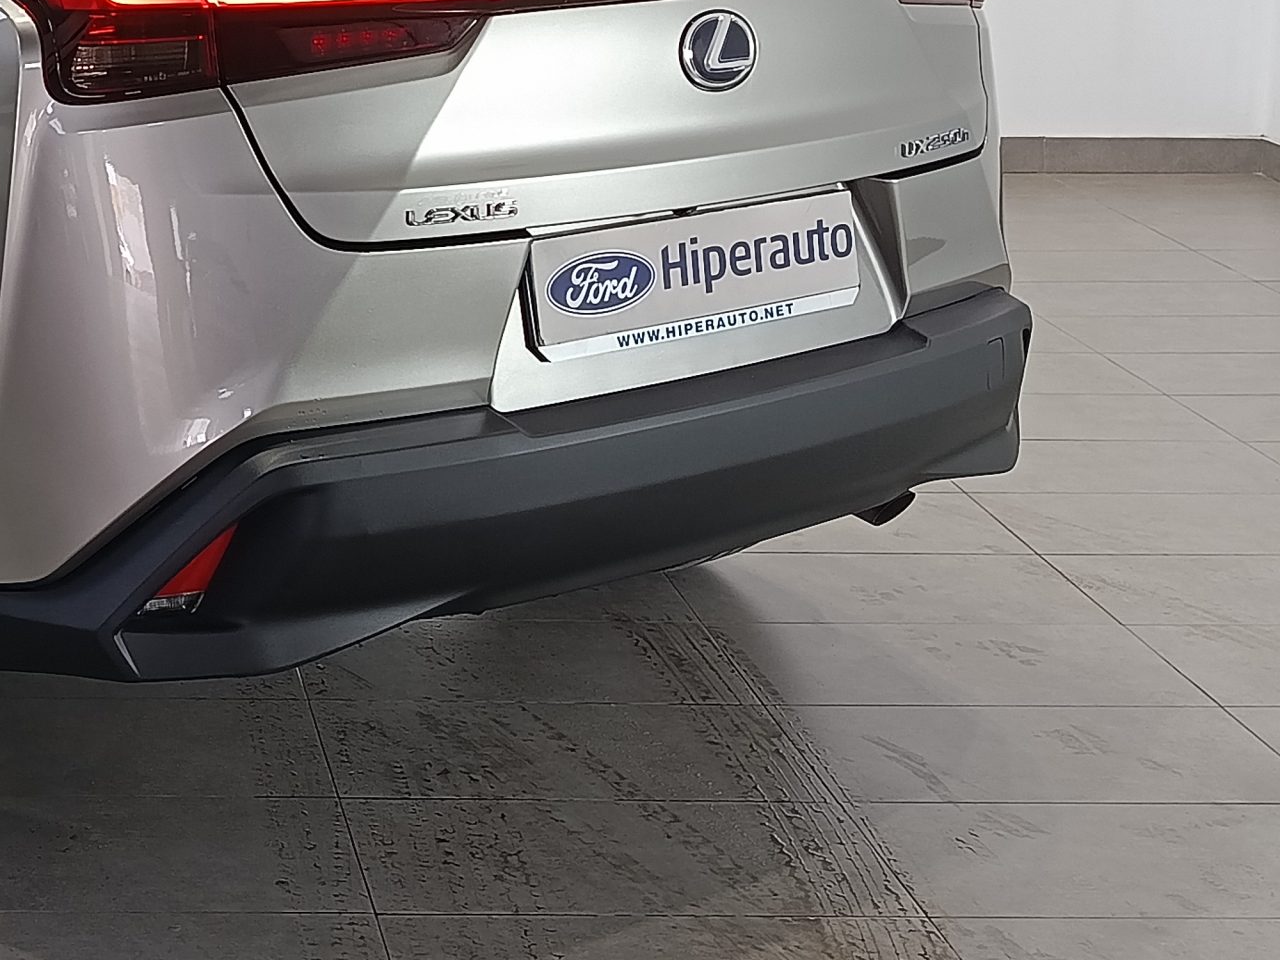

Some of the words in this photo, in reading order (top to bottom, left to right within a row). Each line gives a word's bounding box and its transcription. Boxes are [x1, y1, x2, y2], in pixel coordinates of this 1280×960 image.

[405, 200, 518, 227] LEXUS
[660, 218, 853, 294] Hiperauto
[566, 259, 638, 305] Ford
[617, 303, 794, 349] WWW.HIPERAUTO.NET
